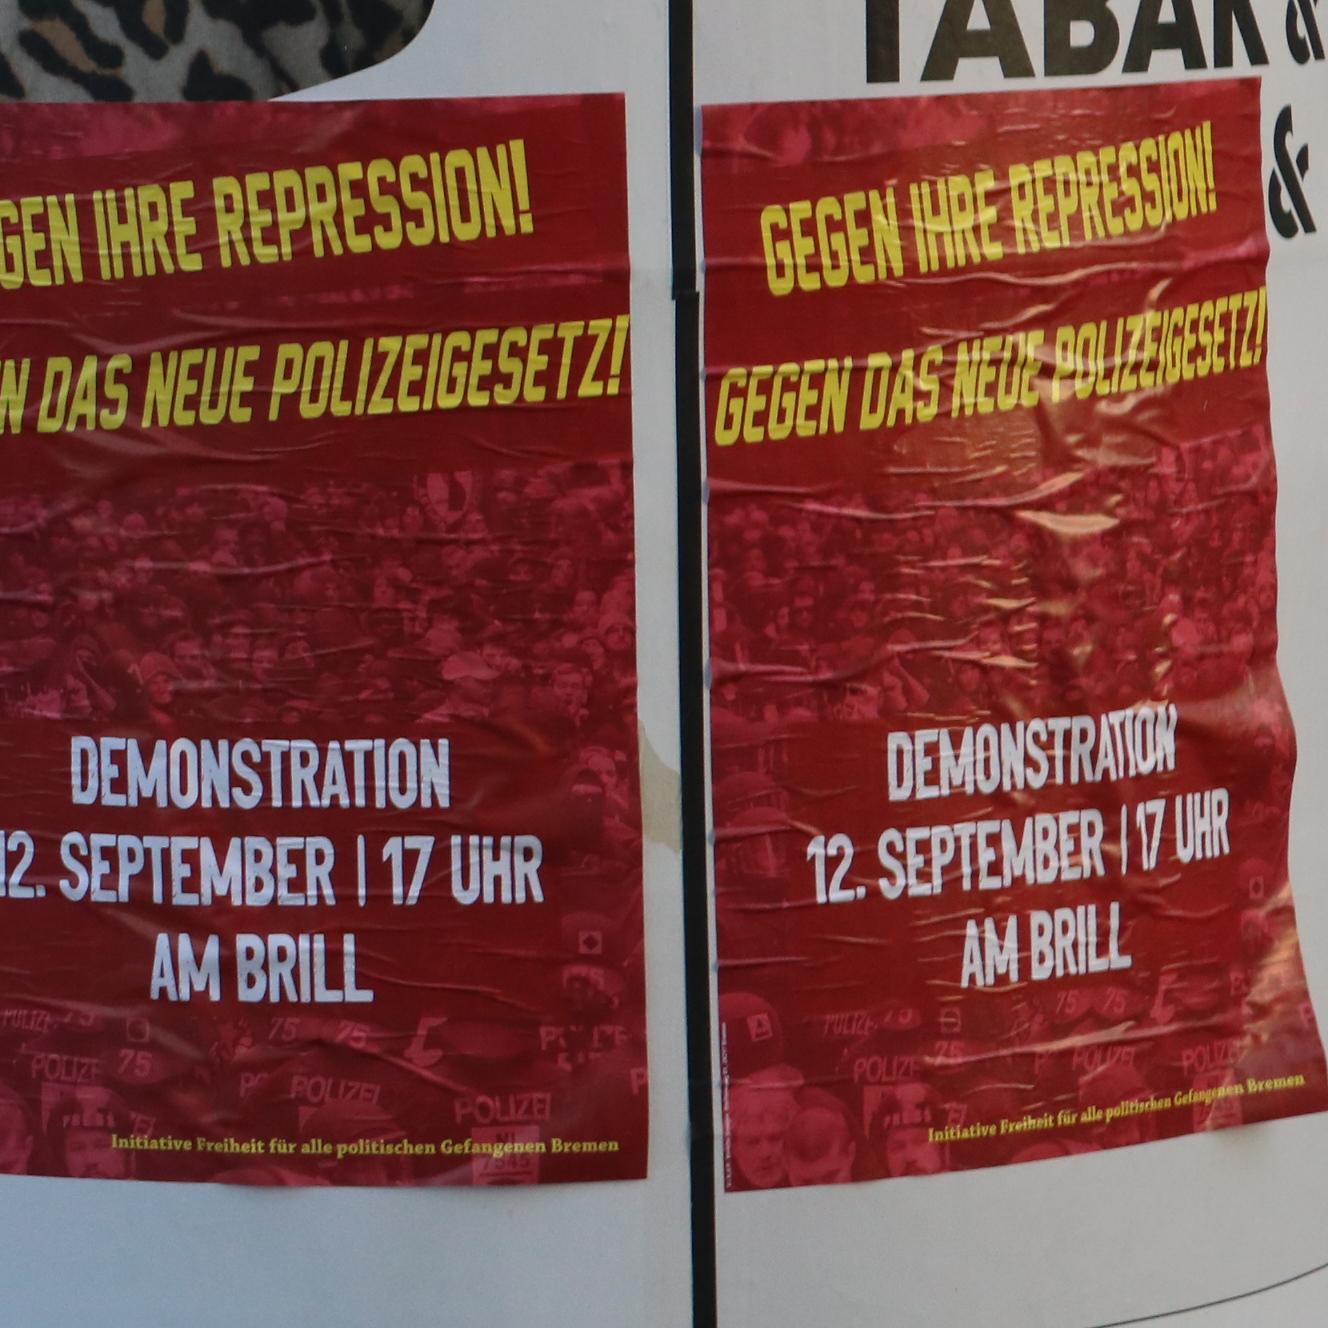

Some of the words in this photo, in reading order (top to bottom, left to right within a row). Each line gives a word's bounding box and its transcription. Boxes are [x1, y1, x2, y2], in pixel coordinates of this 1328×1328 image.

[94, 182, 202, 279] IHRE
[214, 140, 533, 267] REPRESSION!
[760, 186, 903, 296] GEGEN
[910, 168, 1002, 274] IHRE
[1009, 121, 1217, 254] REPRESSION!
[38, 355, 131, 432] DAS
[143, 347, 260, 426] NEUE
[269, 315, 630, 422] POLIZEIGESETZ!
[715, 354, 851, 445] GEGEN
[859, 344, 943, 431] DAS
[951, 329, 1044, 418] NEUE
[1051, 286, 1267, 403] POLIZEIGESETZ!
[71, 736, 449, 809] DEMONSTRATION
[887, 703, 1178, 802] DEMONSTRATION
[59, 832, 335, 906] SEPTEMBER
[383, 836, 434, 904] 17
[451, 835, 543, 904] UHR
[807, 834, 866, 904] 12.
[878, 809, 1104, 899] SEPTEMBER
[1136, 799, 1165, 871] 17
[1174, 788, 1230, 863] UHR
[151, 933, 220, 1001] AM
[236, 934, 373, 1002] BRILL
[961, 915, 1018, 988] AM
[1030, 901, 1132, 980] BRILL
[111, 1134, 192, 1151] Initiative
[197, 1136, 264, 1153] Freiheit
[269, 1136, 296, 1154] für
[301, 1138, 332, 1154] alle
[337, 1137, 435, 1158] politischen
[440, 1139, 546, 1157] Gefangenen
[551, 1138, 618, 1153] Bremen
